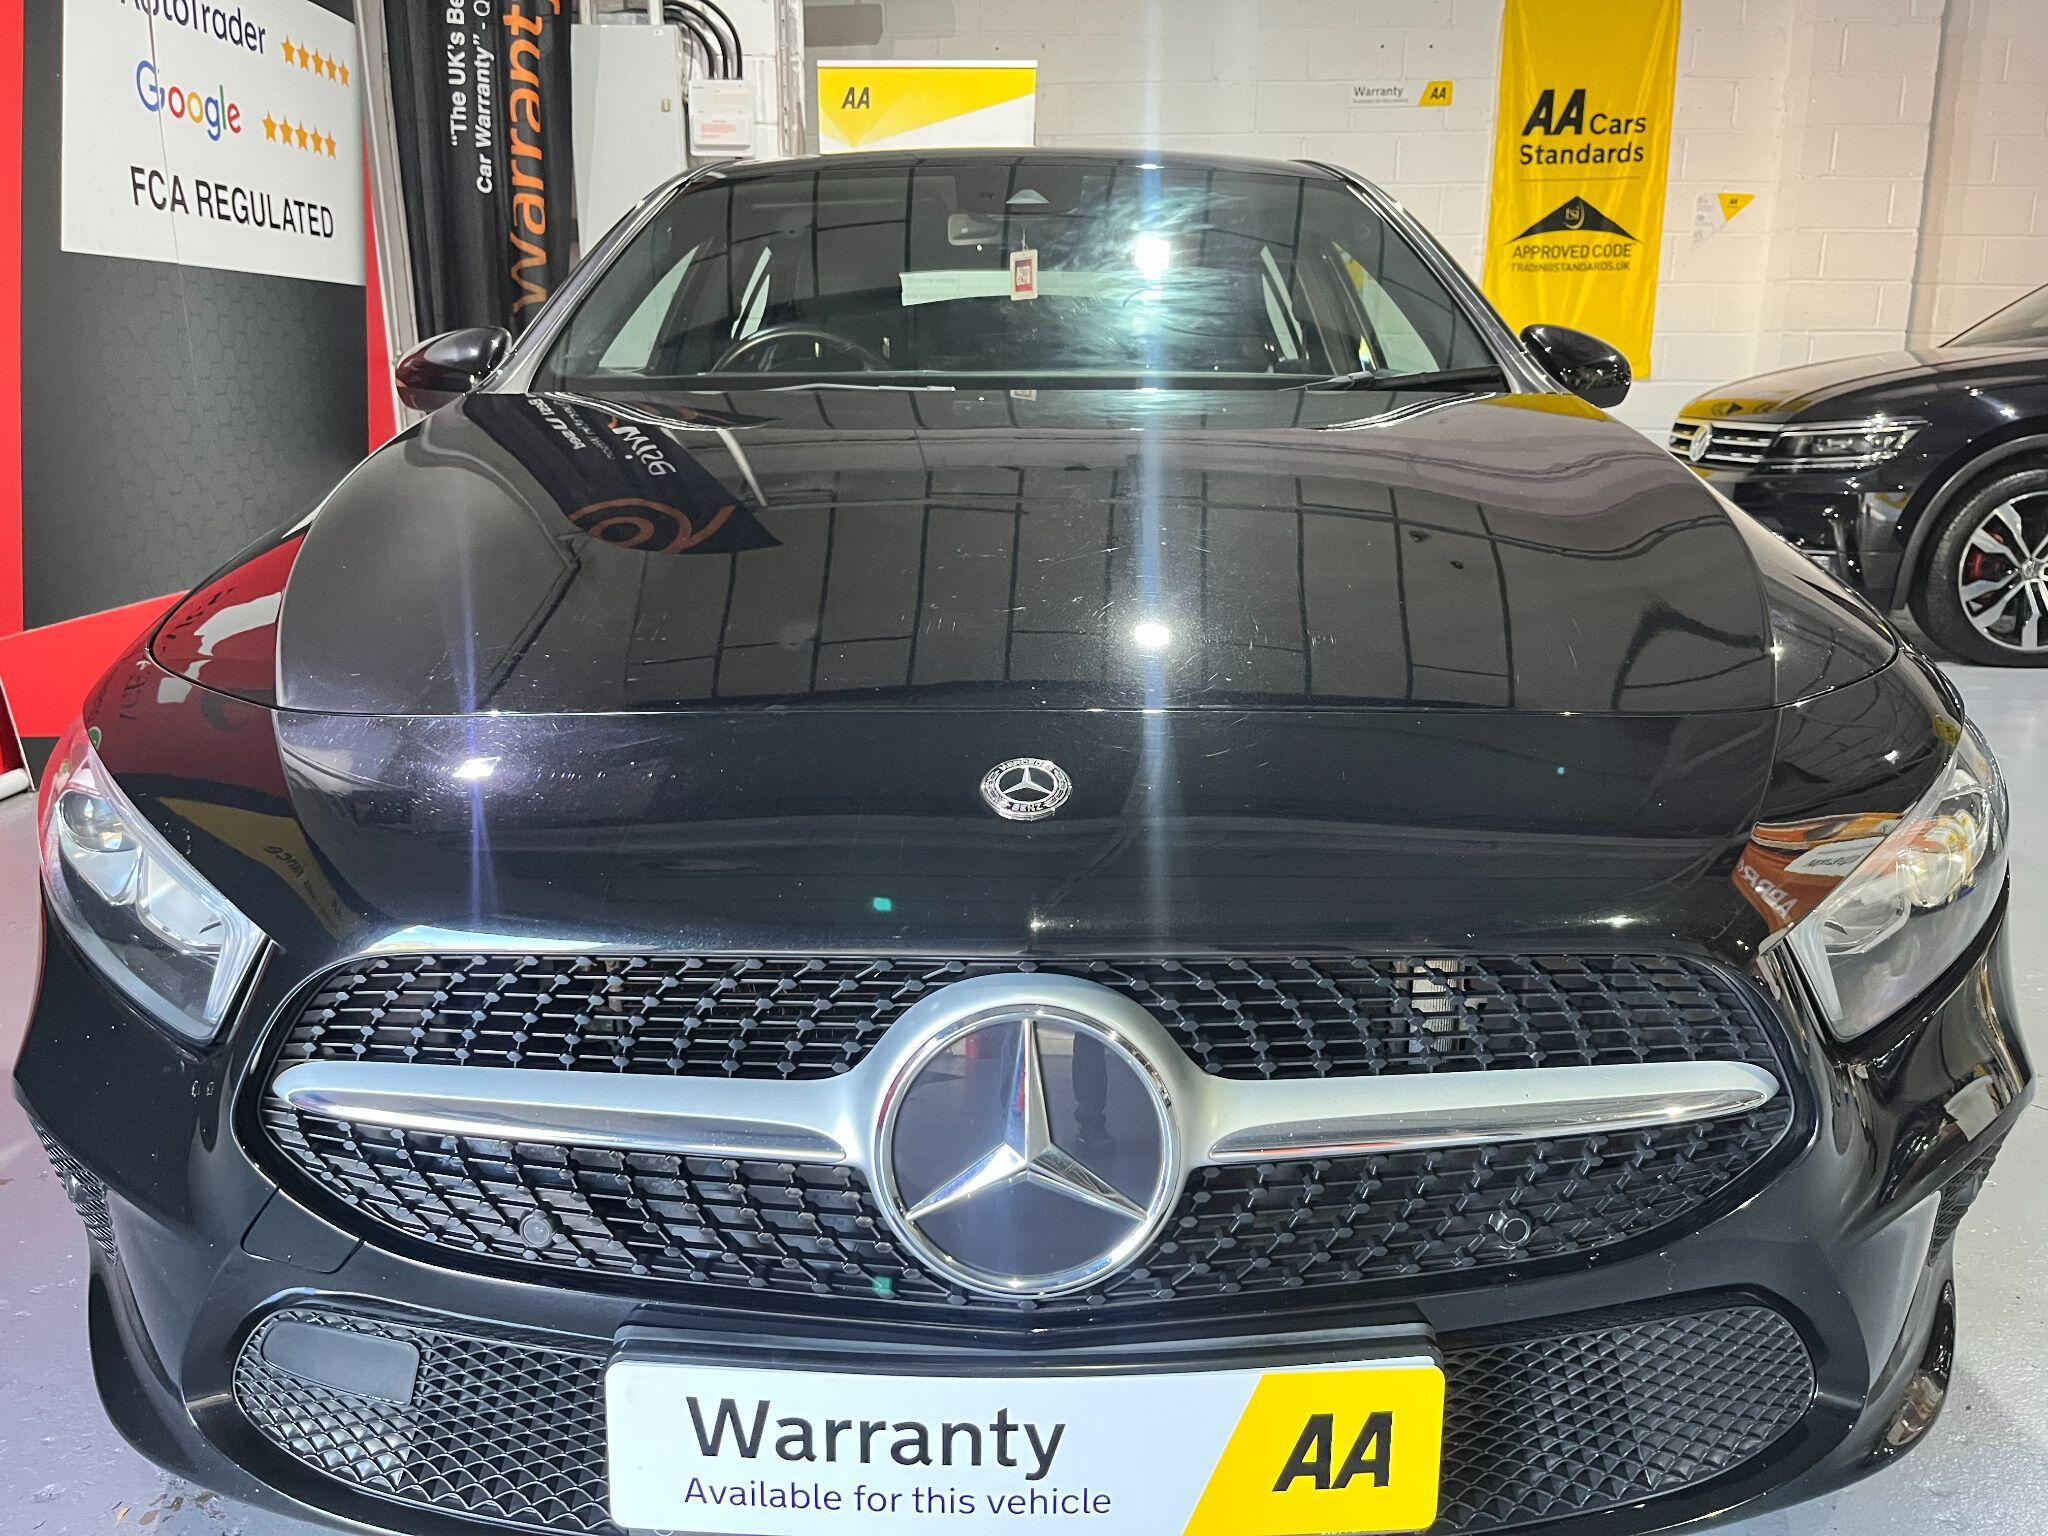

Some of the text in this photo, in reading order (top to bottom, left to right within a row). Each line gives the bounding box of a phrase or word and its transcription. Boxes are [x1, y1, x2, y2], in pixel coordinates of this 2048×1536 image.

[121, 0, 266, 54] utoTrader
[136, 60, 242, 141] Google
[842, 87, 870, 110] AA
[1353, 85, 1404, 98] Warranty
[1429, 86, 1447, 100] AA
[1522, 88, 1647, 136] AA Cars
[476, 153, 493, 194] Car
[1519, 142, 1644, 166] Standards
[130, 166, 334, 239] FCA REGULATED
[1511, 260, 1631, 273] TRADINGSTANDARDS.UK
[1512, 242, 1632, 260] APPROVED CODE
[685, 1396, 1067, 1481] Warranty
[1271, 1411, 1393, 1493] AA
[684, 1476, 1112, 1516] Available for this vehicle
